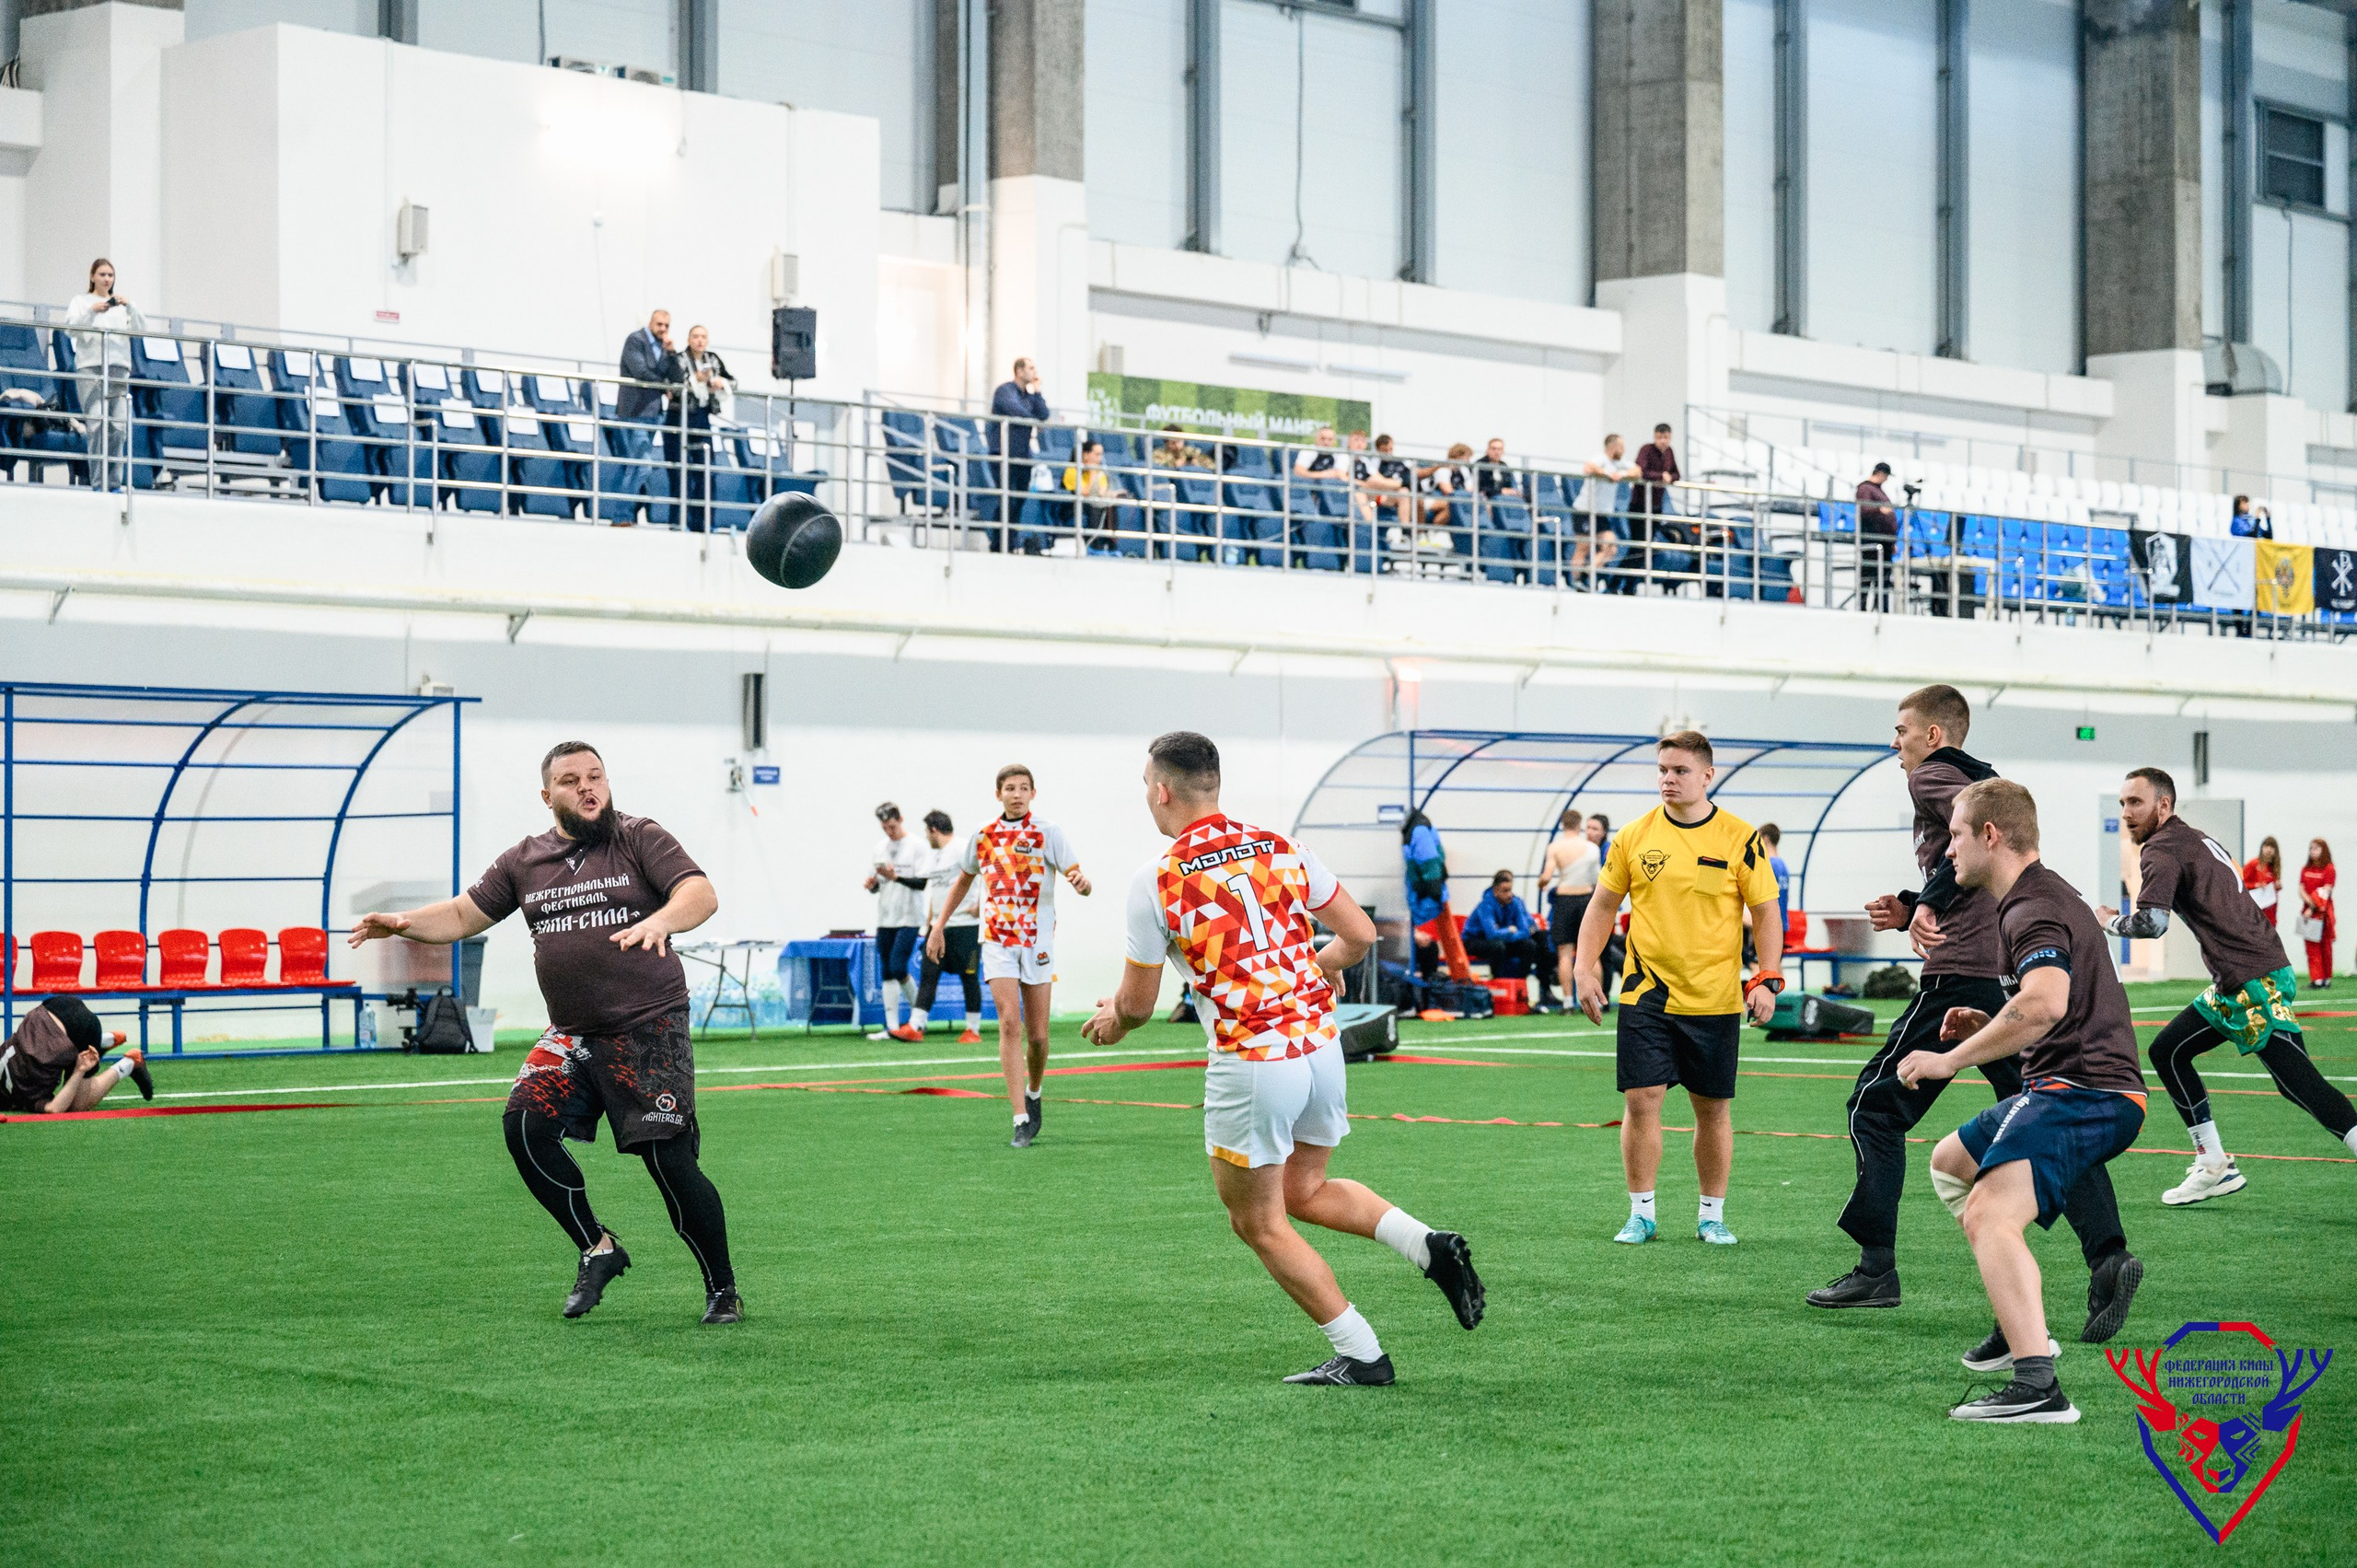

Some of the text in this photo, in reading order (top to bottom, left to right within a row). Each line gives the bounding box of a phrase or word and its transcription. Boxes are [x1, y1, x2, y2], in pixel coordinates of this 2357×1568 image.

[1178, 840, 1272, 877] МОЛОТ
[525, 873, 630, 904] МЕЖРЕГИОНАЛЬНЫЙ
[540, 891, 608, 914] ФЕСТИВАЛЬ
[1225, 872, 1270, 952] 1
